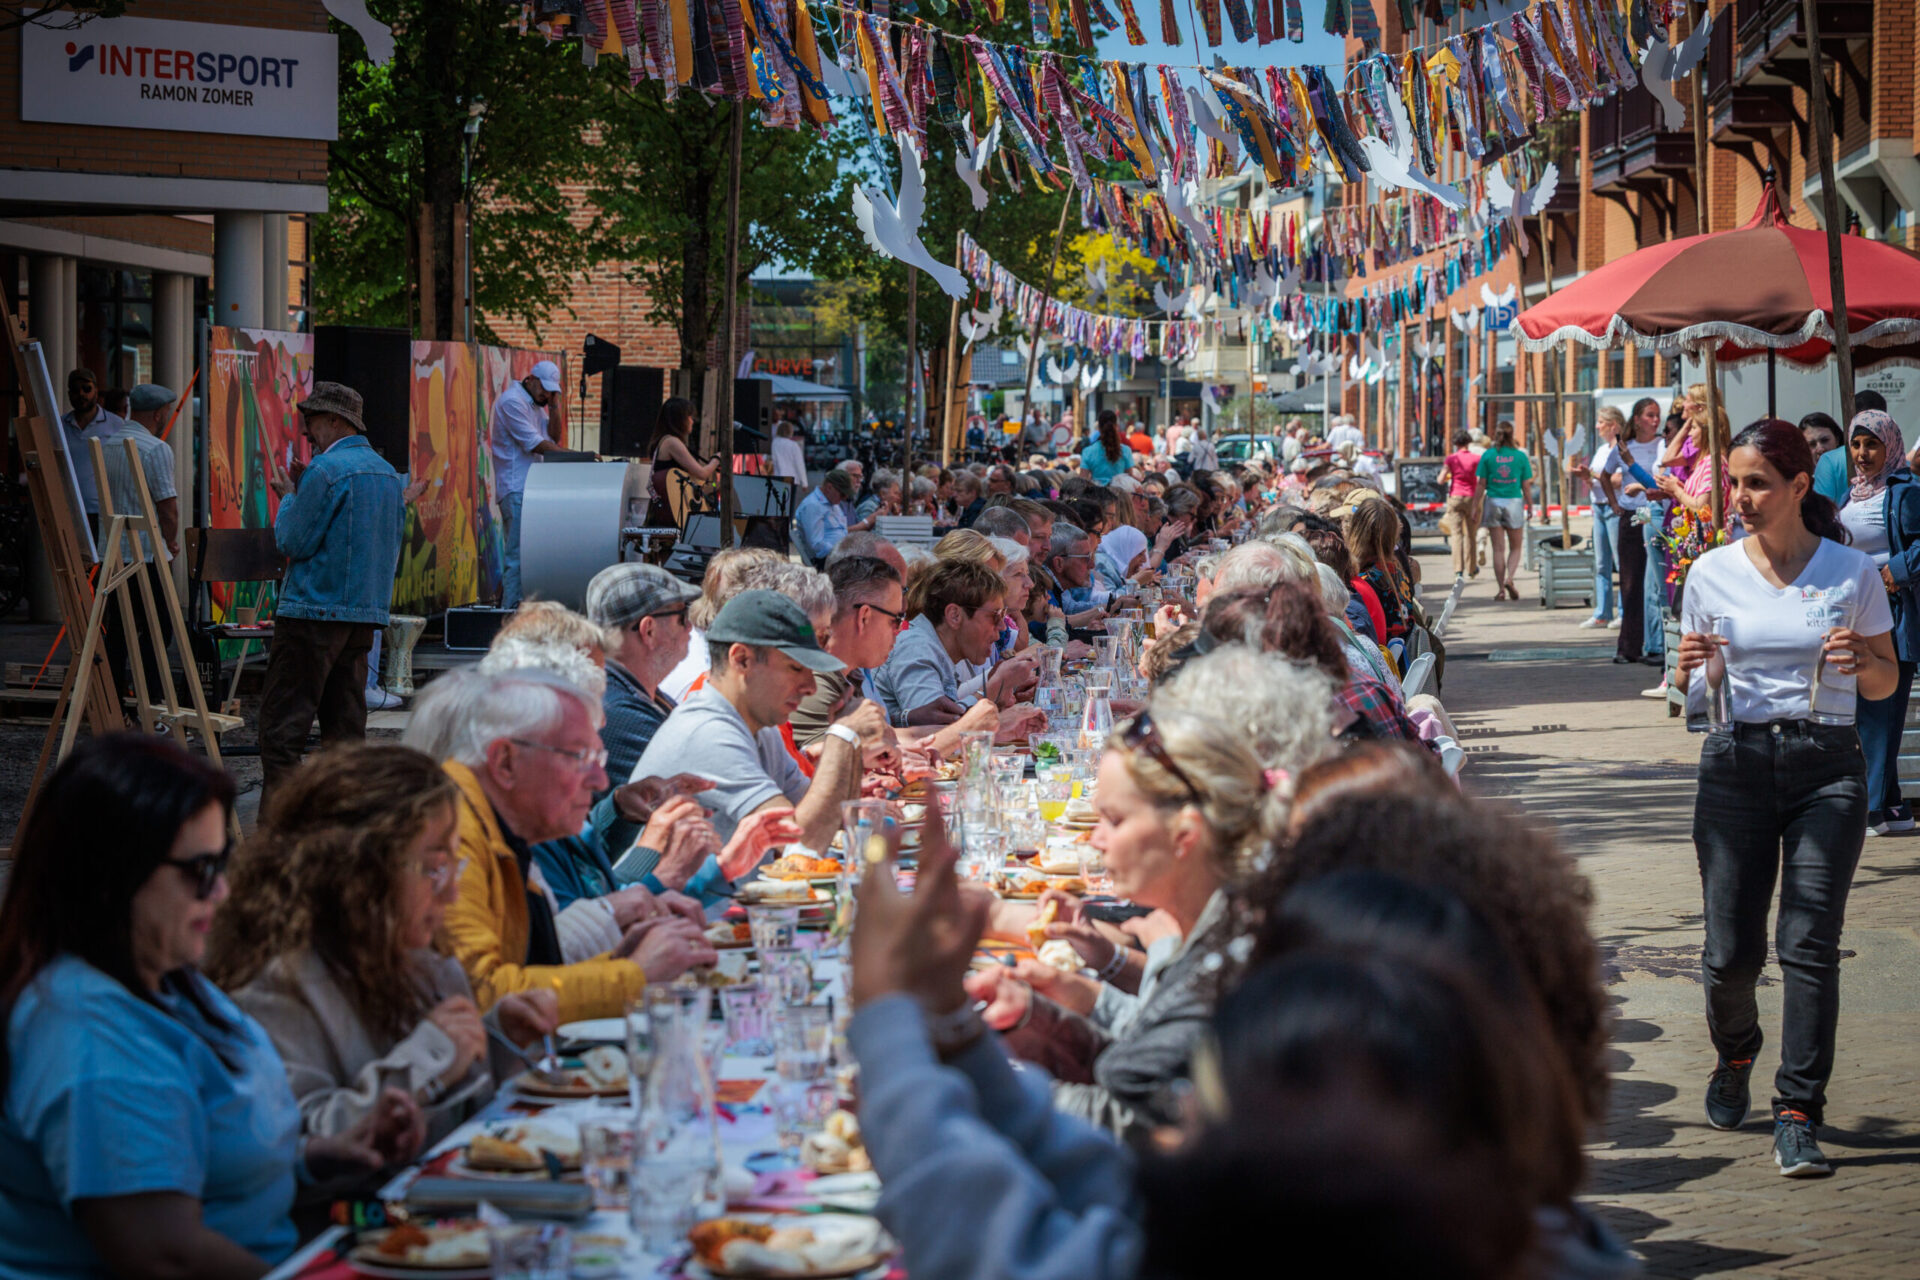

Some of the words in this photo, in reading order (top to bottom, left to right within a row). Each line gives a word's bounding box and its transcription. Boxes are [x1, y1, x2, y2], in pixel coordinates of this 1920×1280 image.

[100, 43, 299, 88] INTERSPORT
[141, 83, 197, 102] RAMON
[202, 87, 254, 106] ZOMER
[754, 358, 813, 375] CURVE
